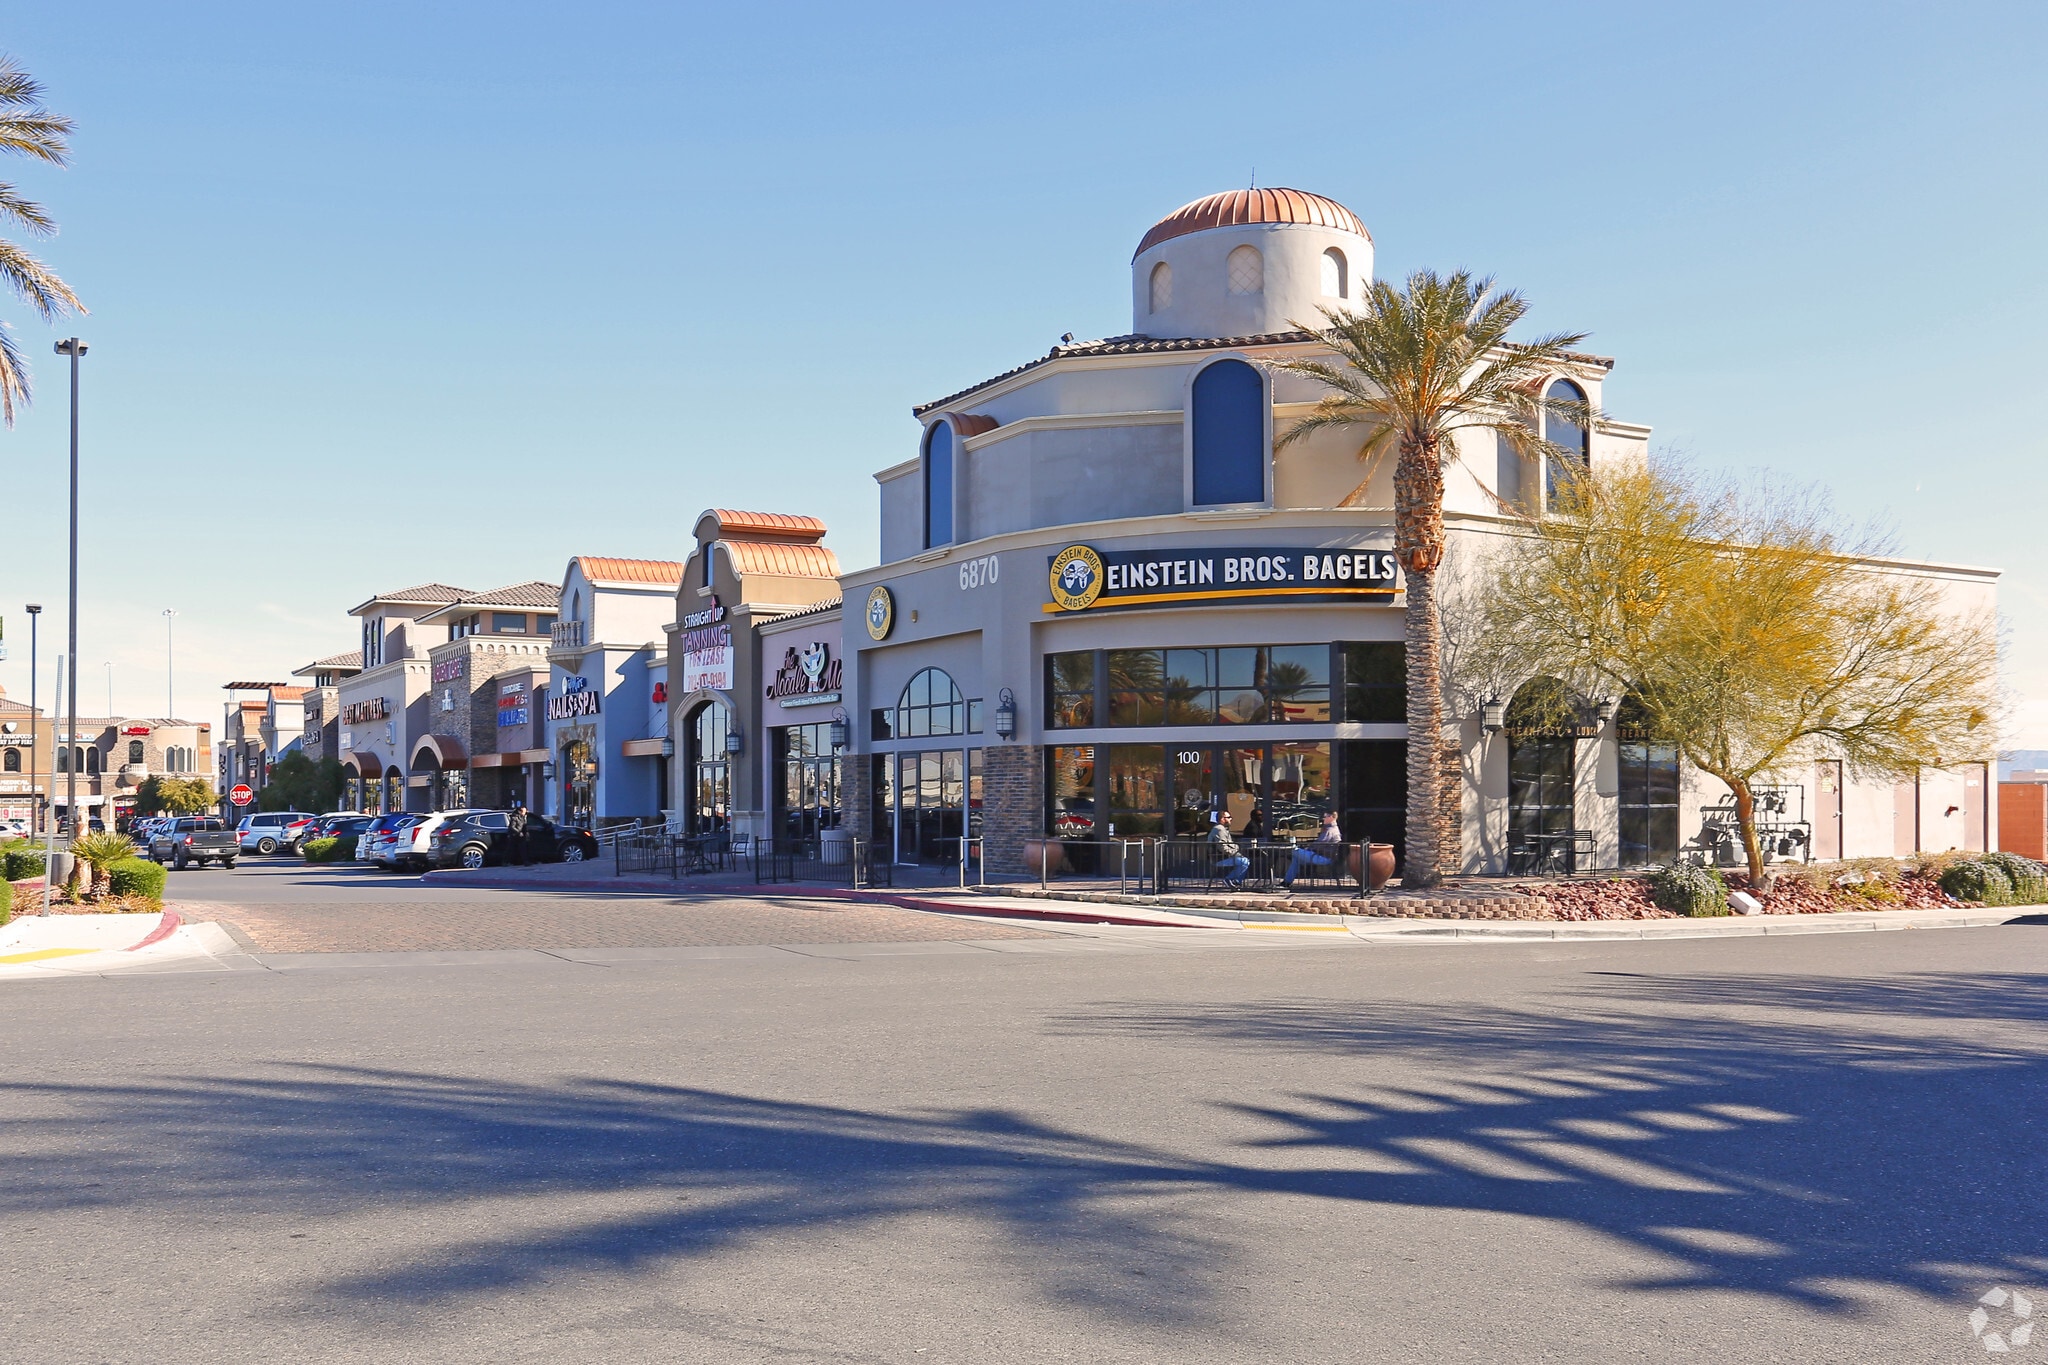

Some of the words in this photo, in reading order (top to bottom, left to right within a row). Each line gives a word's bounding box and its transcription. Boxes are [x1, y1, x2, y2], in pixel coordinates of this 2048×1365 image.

[959, 555, 999, 591] 6870
[1053, 548, 1082, 575] EINSTEIN
[1083, 549, 1101, 571] BROS
[1107, 559, 1214, 590] EINSTEIN
[1224, 556, 1295, 583] BROS.
[1303, 554, 1396, 581] BAGELS
[1063, 593, 1092, 608] BAGELS
[684, 609, 712, 629] STRAIGHT
[714, 606, 724, 622] UP
[680, 624, 727, 653] TANNING
[702, 646, 726, 666] LEASE
[784, 647, 796, 670] the
[767, 665, 807, 699] Noodle
[343, 703, 354, 725] BEST
[355, 698, 384, 724] MATTRESS
[549, 694, 574, 720] NAILS
[578, 691, 597, 716] SPA
[1177, 751, 1200, 764] 100
[232, 790, 251, 800] STOP
